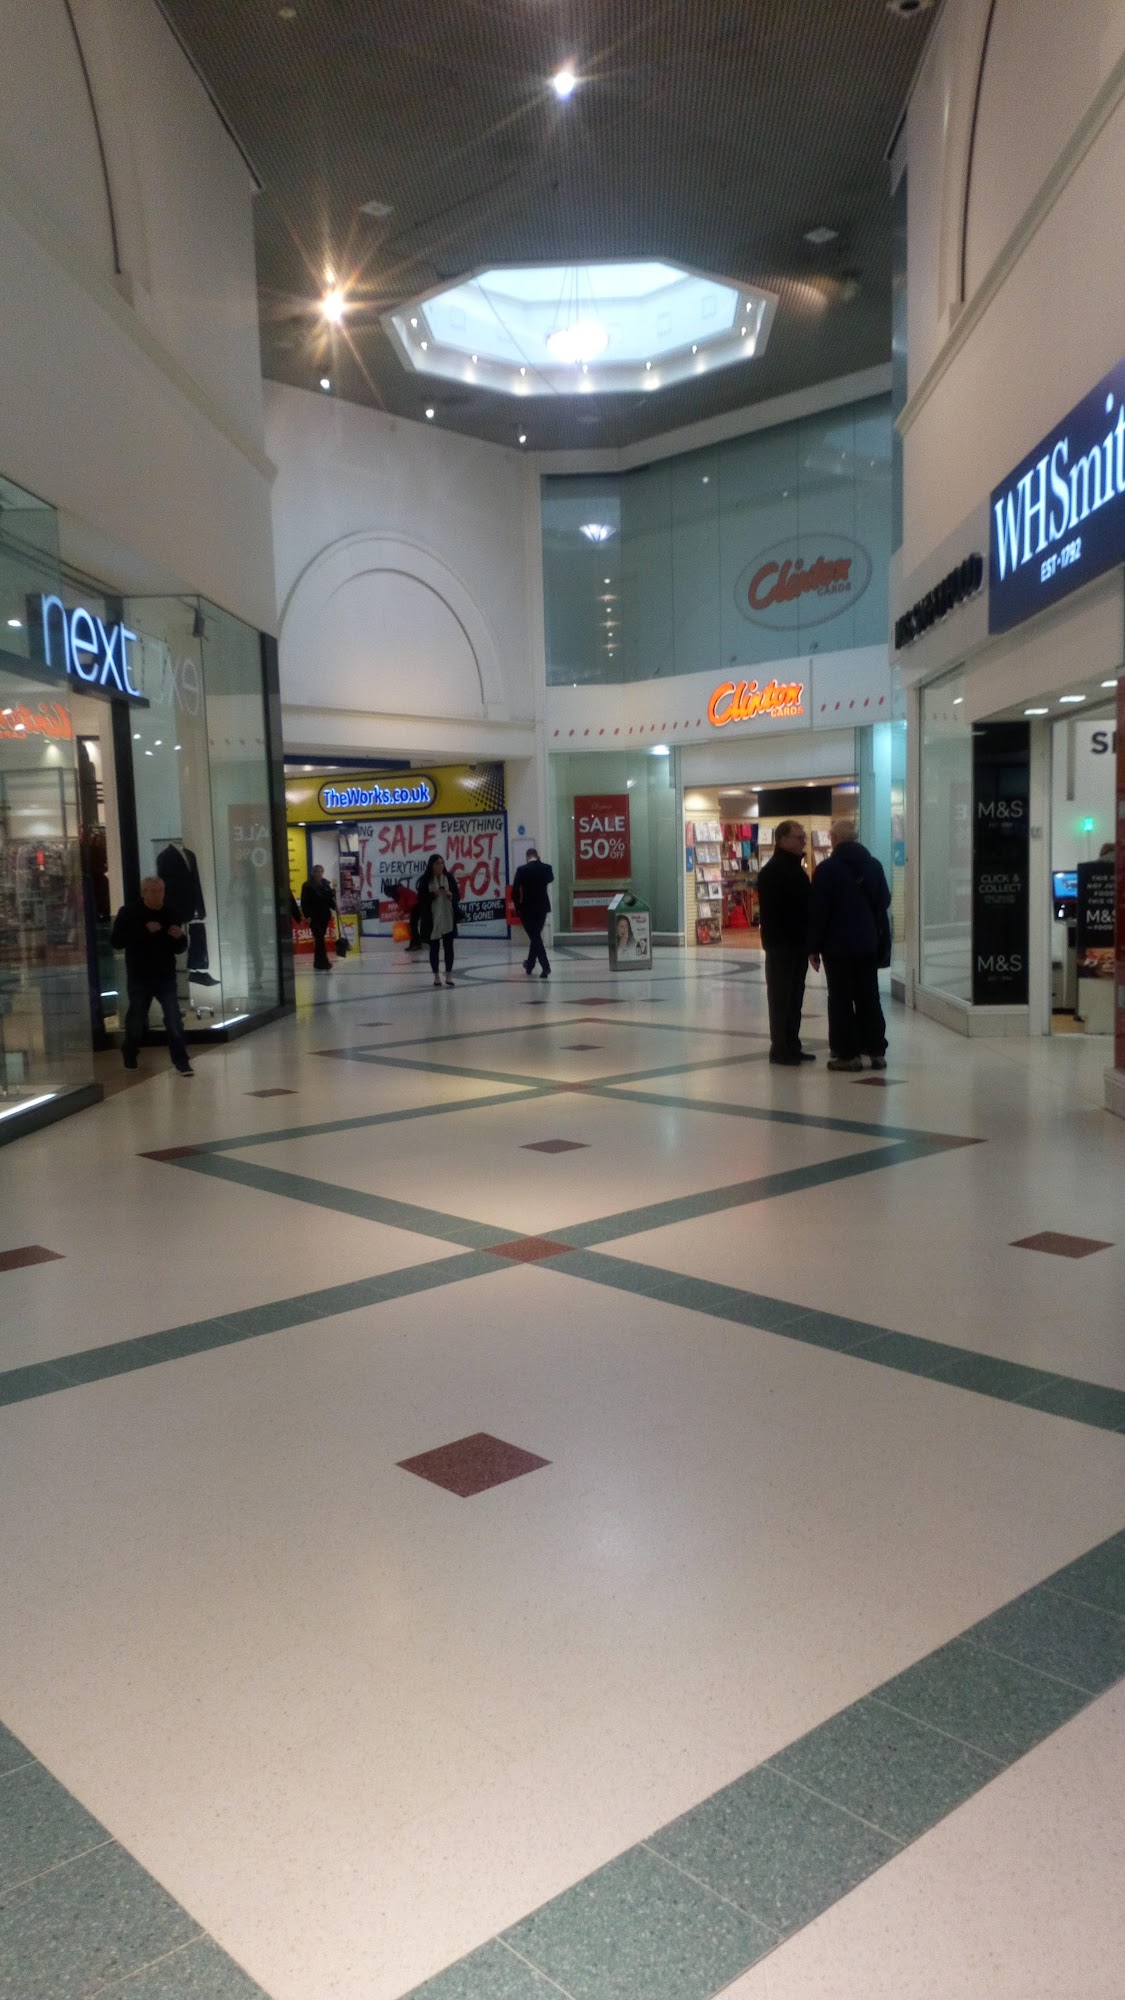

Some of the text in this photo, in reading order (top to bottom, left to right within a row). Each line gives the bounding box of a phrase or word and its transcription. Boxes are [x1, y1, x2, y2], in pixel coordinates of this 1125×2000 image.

[994, 392, 1125, 581] WHSmit
[1040, 536, 1082, 583] EST 1792
[748, 555, 852, 610] Clinton
[817, 581, 852, 597] CARDS
[41, 593, 140, 696] next
[707, 679, 804, 727] Clinton
[770, 705, 804, 718] CARDS
[1090, 731, 1117, 755] S
[323, 782, 431, 808] TheWorks.co.uk
[978, 801, 1023, 818] M&S
[440, 818, 504, 833] EVERYTHING
[579, 816, 626, 833] SALE
[378, 823, 437, 857] SALE
[445, 832, 498, 860] MUST
[579, 838, 626, 860] 50%
[610, 851, 625, 859] OFF
[379, 861, 428, 876] EVERYTHIN
[980, 874, 1008, 884] CLICK
[978, 883, 1022, 894] COLLECT
[468, 901, 480, 912] IT'S
[481, 900, 504, 911] GONE,
[472, 910, 494, 921] GONE!
[977, 955, 1022, 972] M&S
